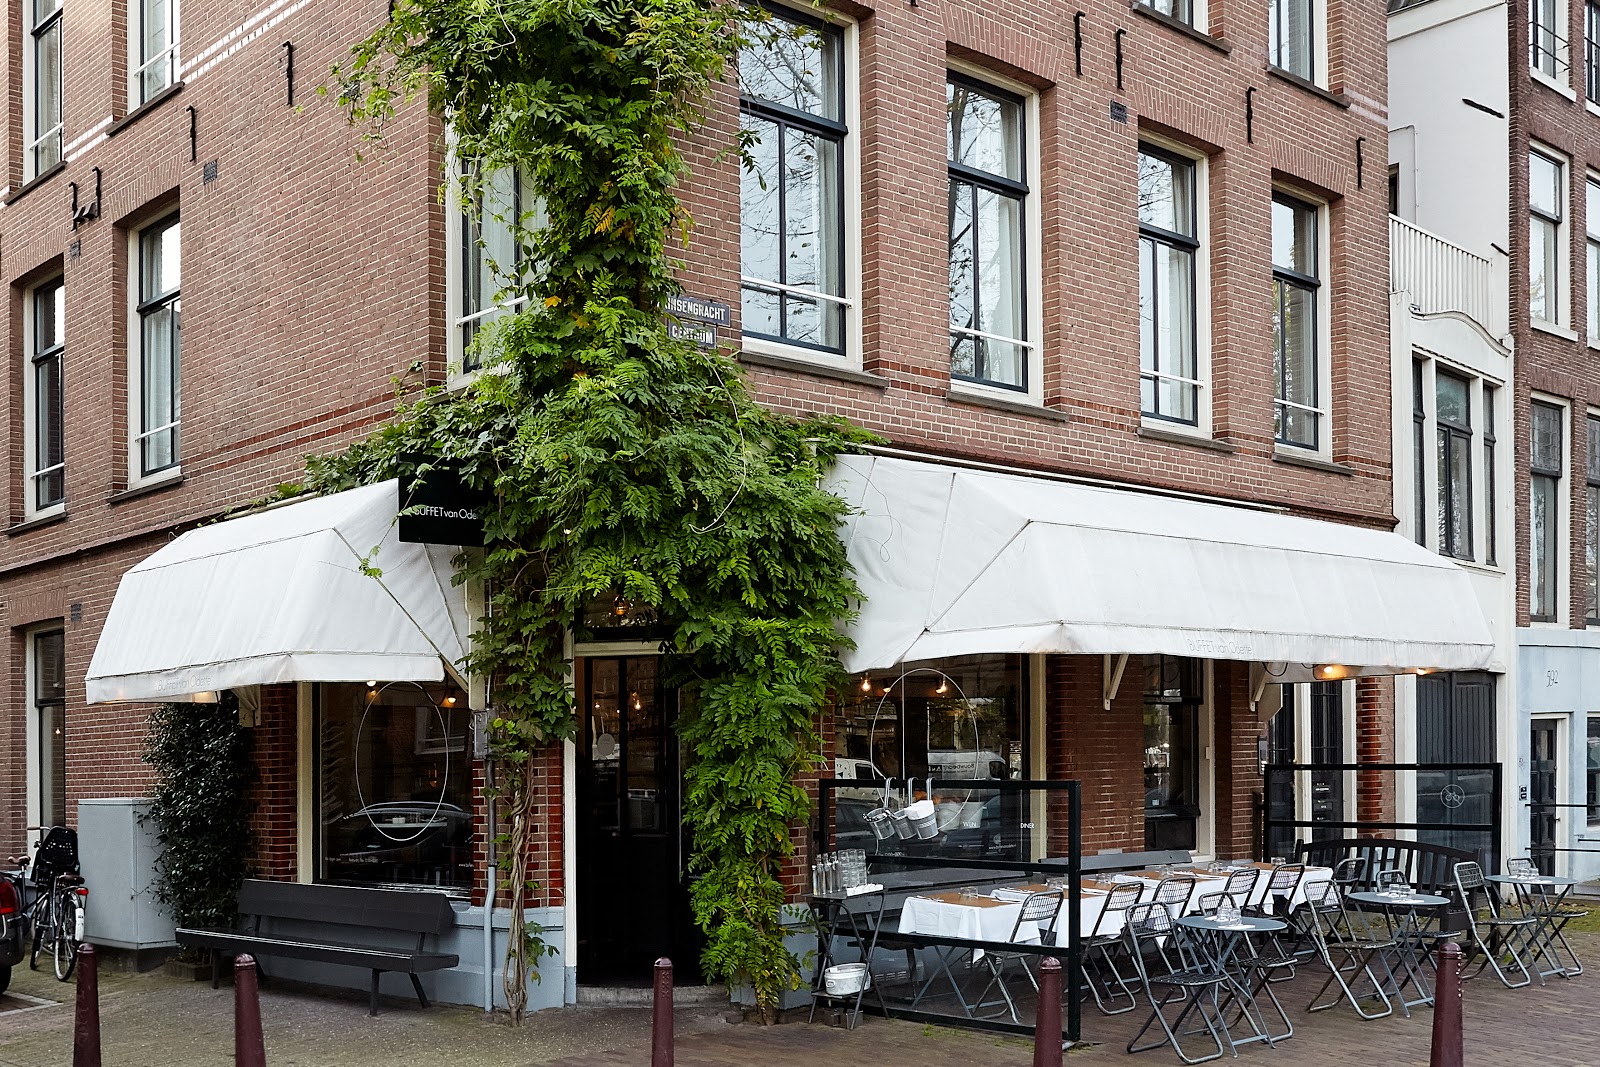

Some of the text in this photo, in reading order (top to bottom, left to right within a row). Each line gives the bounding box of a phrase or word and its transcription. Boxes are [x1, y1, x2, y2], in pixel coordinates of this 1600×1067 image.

[657, 297, 725, 320] INSENGRACHT
[444, 510, 458, 518] van
[1546, 670, 1558, 687] 592
